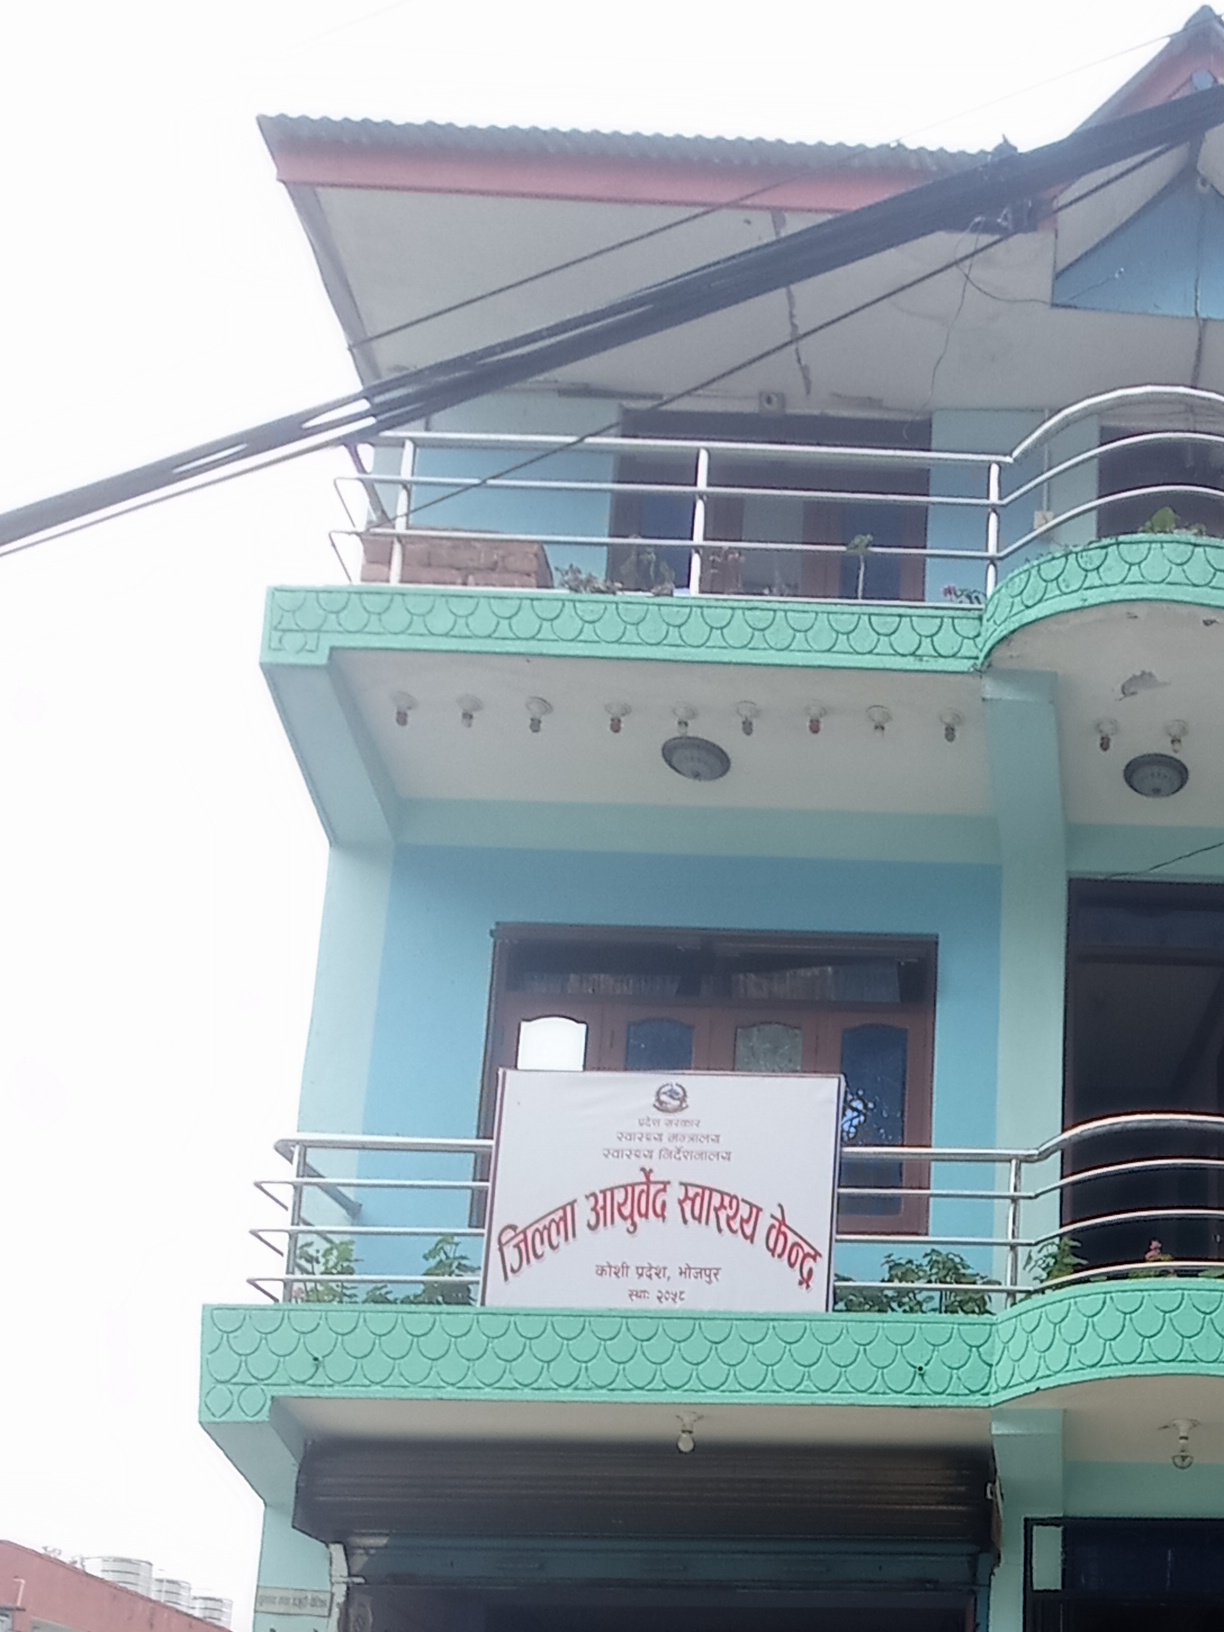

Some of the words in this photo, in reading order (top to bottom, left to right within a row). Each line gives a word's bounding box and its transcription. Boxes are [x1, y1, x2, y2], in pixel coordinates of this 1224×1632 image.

[638, 1117, 660, 1128] प्रदेश
[663, 1118, 701, 1128] सरकार
[498, 1201, 577, 1282] जिल्ला
[585, 1167, 671, 1234] आयुर्वेद
[677, 1181, 763, 1244] स्वास्थ्य
[765, 1203, 822, 1289] केन्द्र
[595, 1261, 630, 1278] कोशी
[635, 1262, 671, 1282] प्रदेश,
[678, 1262, 722, 1285] भोजपुर
[656, 1289, 686, 1304] २०५८
